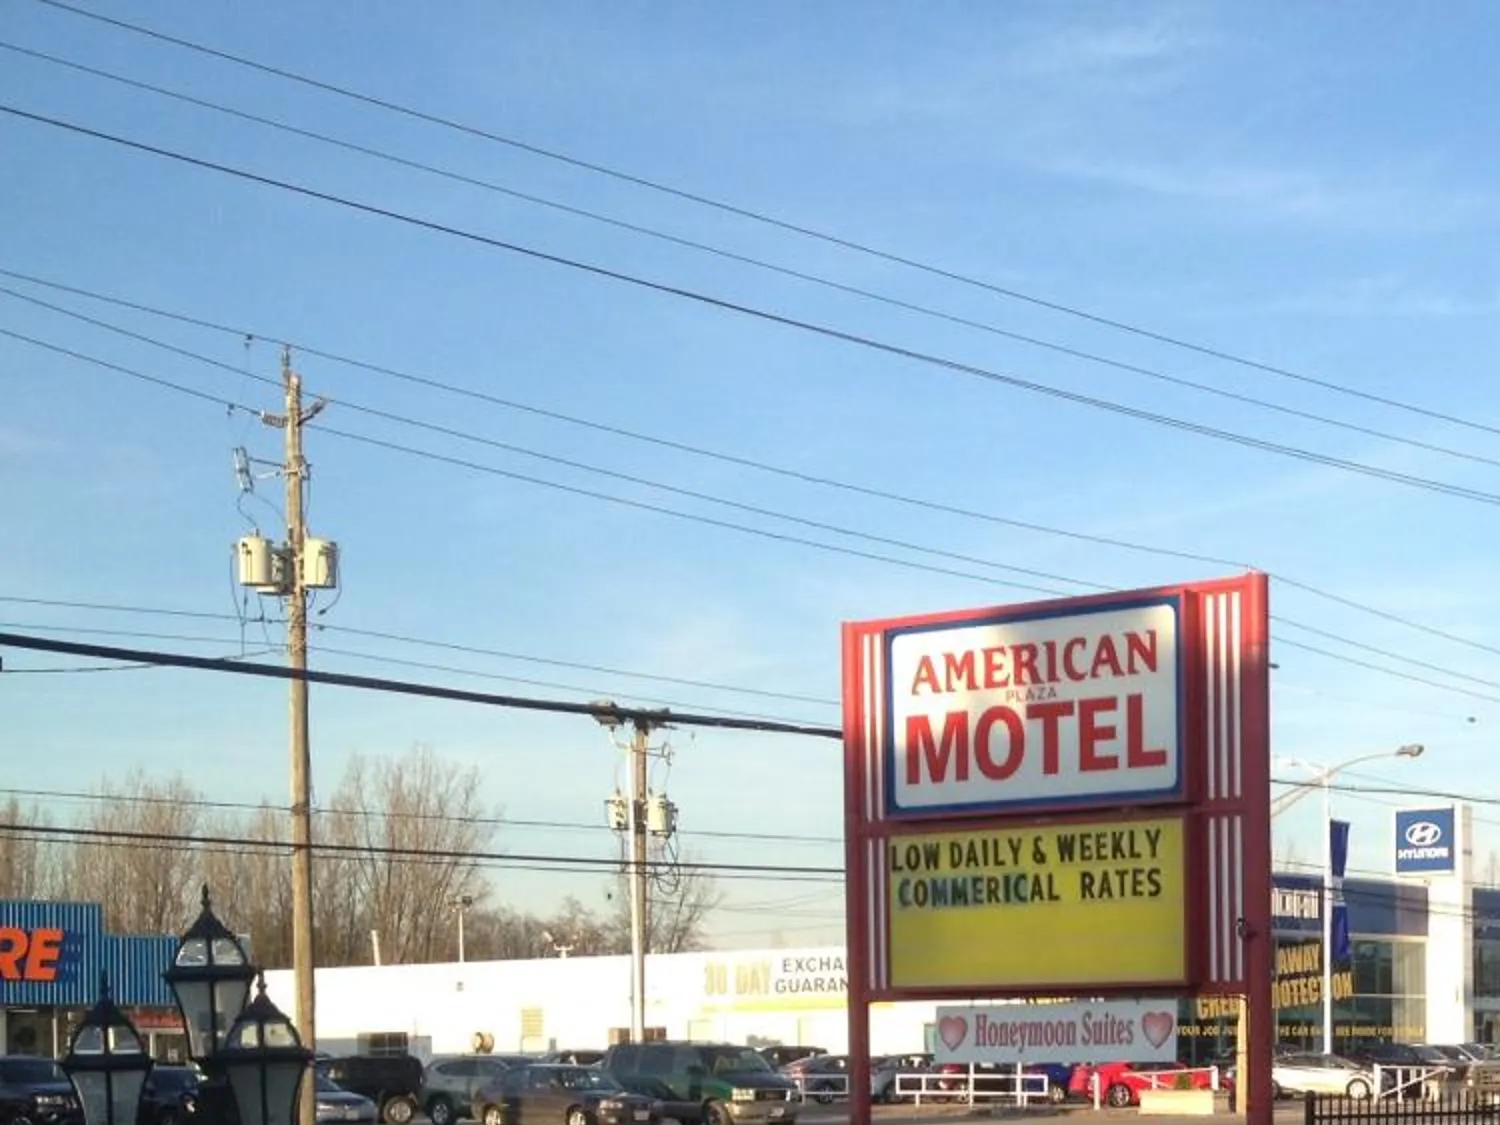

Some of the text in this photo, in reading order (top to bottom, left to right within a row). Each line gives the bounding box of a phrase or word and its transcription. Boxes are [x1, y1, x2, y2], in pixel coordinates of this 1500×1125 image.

[911, 629, 1158, 695] AMERICAN
[1005, 686, 1057, 702] PLAZA
[905, 694, 1167, 785] MOTEL
[890, 828, 1162, 873] LOW DAILY & WEEKLY
[1397, 847, 1449, 860] HYUNDAI
[896, 867, 1161, 908] COMMERICAL RATES
[781, 956, 845, 973] EXCHA
[775, 977, 848, 994] GUARAN
[974, 1010, 1134, 1053] Honeymoon Suites
